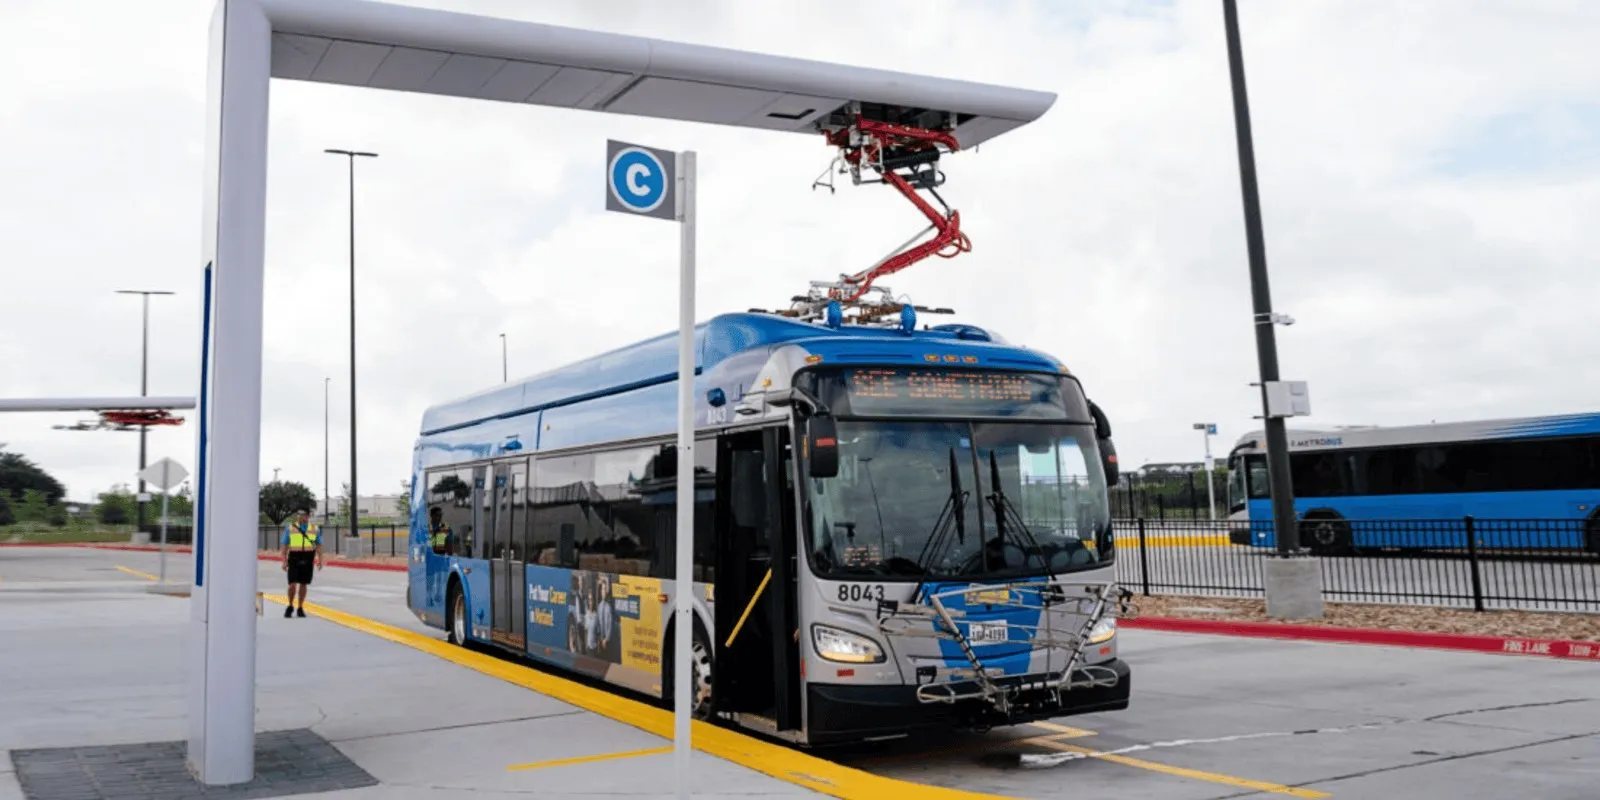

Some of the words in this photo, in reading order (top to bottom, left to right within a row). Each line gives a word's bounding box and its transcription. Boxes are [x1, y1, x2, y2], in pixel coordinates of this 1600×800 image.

[626, 162, 651, 196] C
[853, 369, 898, 397] SEE
[908, 372, 1032, 400] SOMETHING
[1297, 437, 1344, 448] METROBUS
[838, 584, 884, 602] 8043
[1525, 641, 1552, 655] LANE
